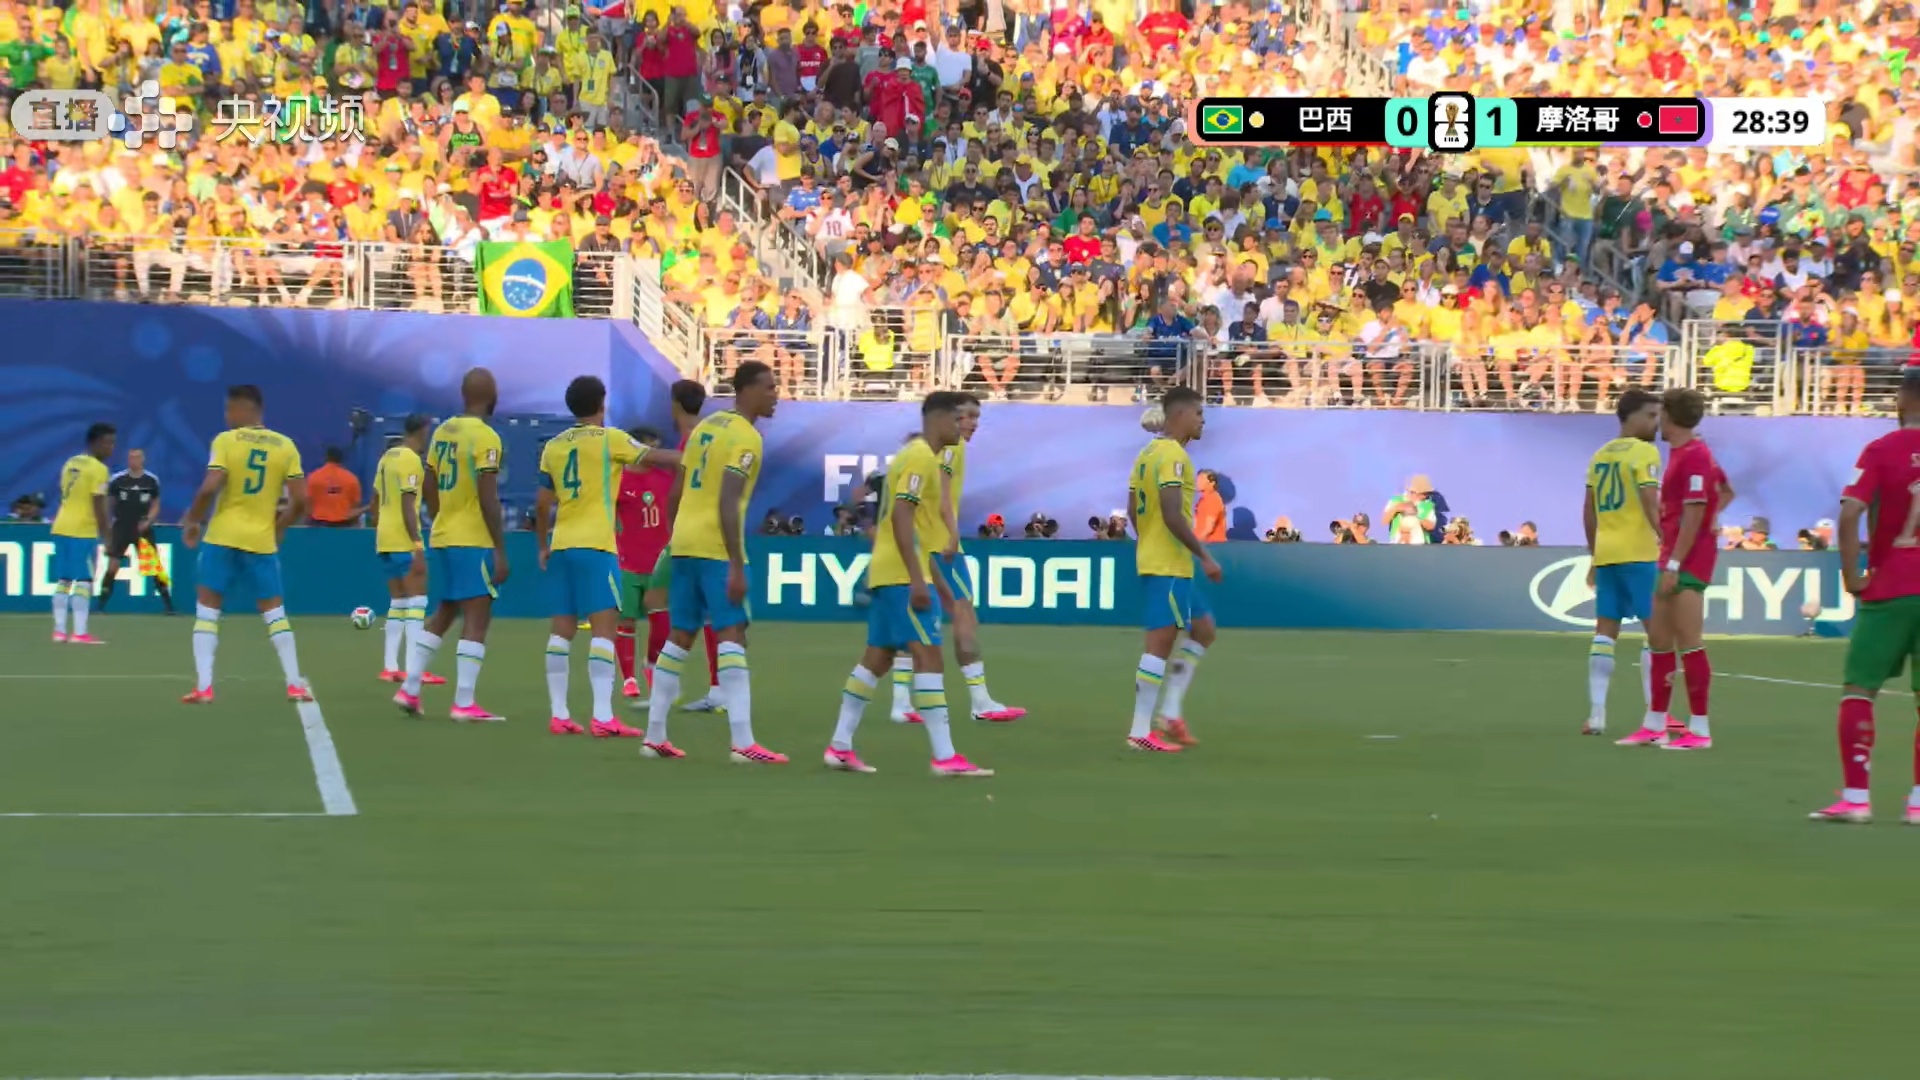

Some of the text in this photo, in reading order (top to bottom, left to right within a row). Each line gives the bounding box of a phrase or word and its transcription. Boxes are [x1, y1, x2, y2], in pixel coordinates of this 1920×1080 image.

[243, 448, 268, 495] 5
[562, 448, 582, 500] 4
[1593, 461, 1626, 513] 20
[642, 505, 660, 529] 10
